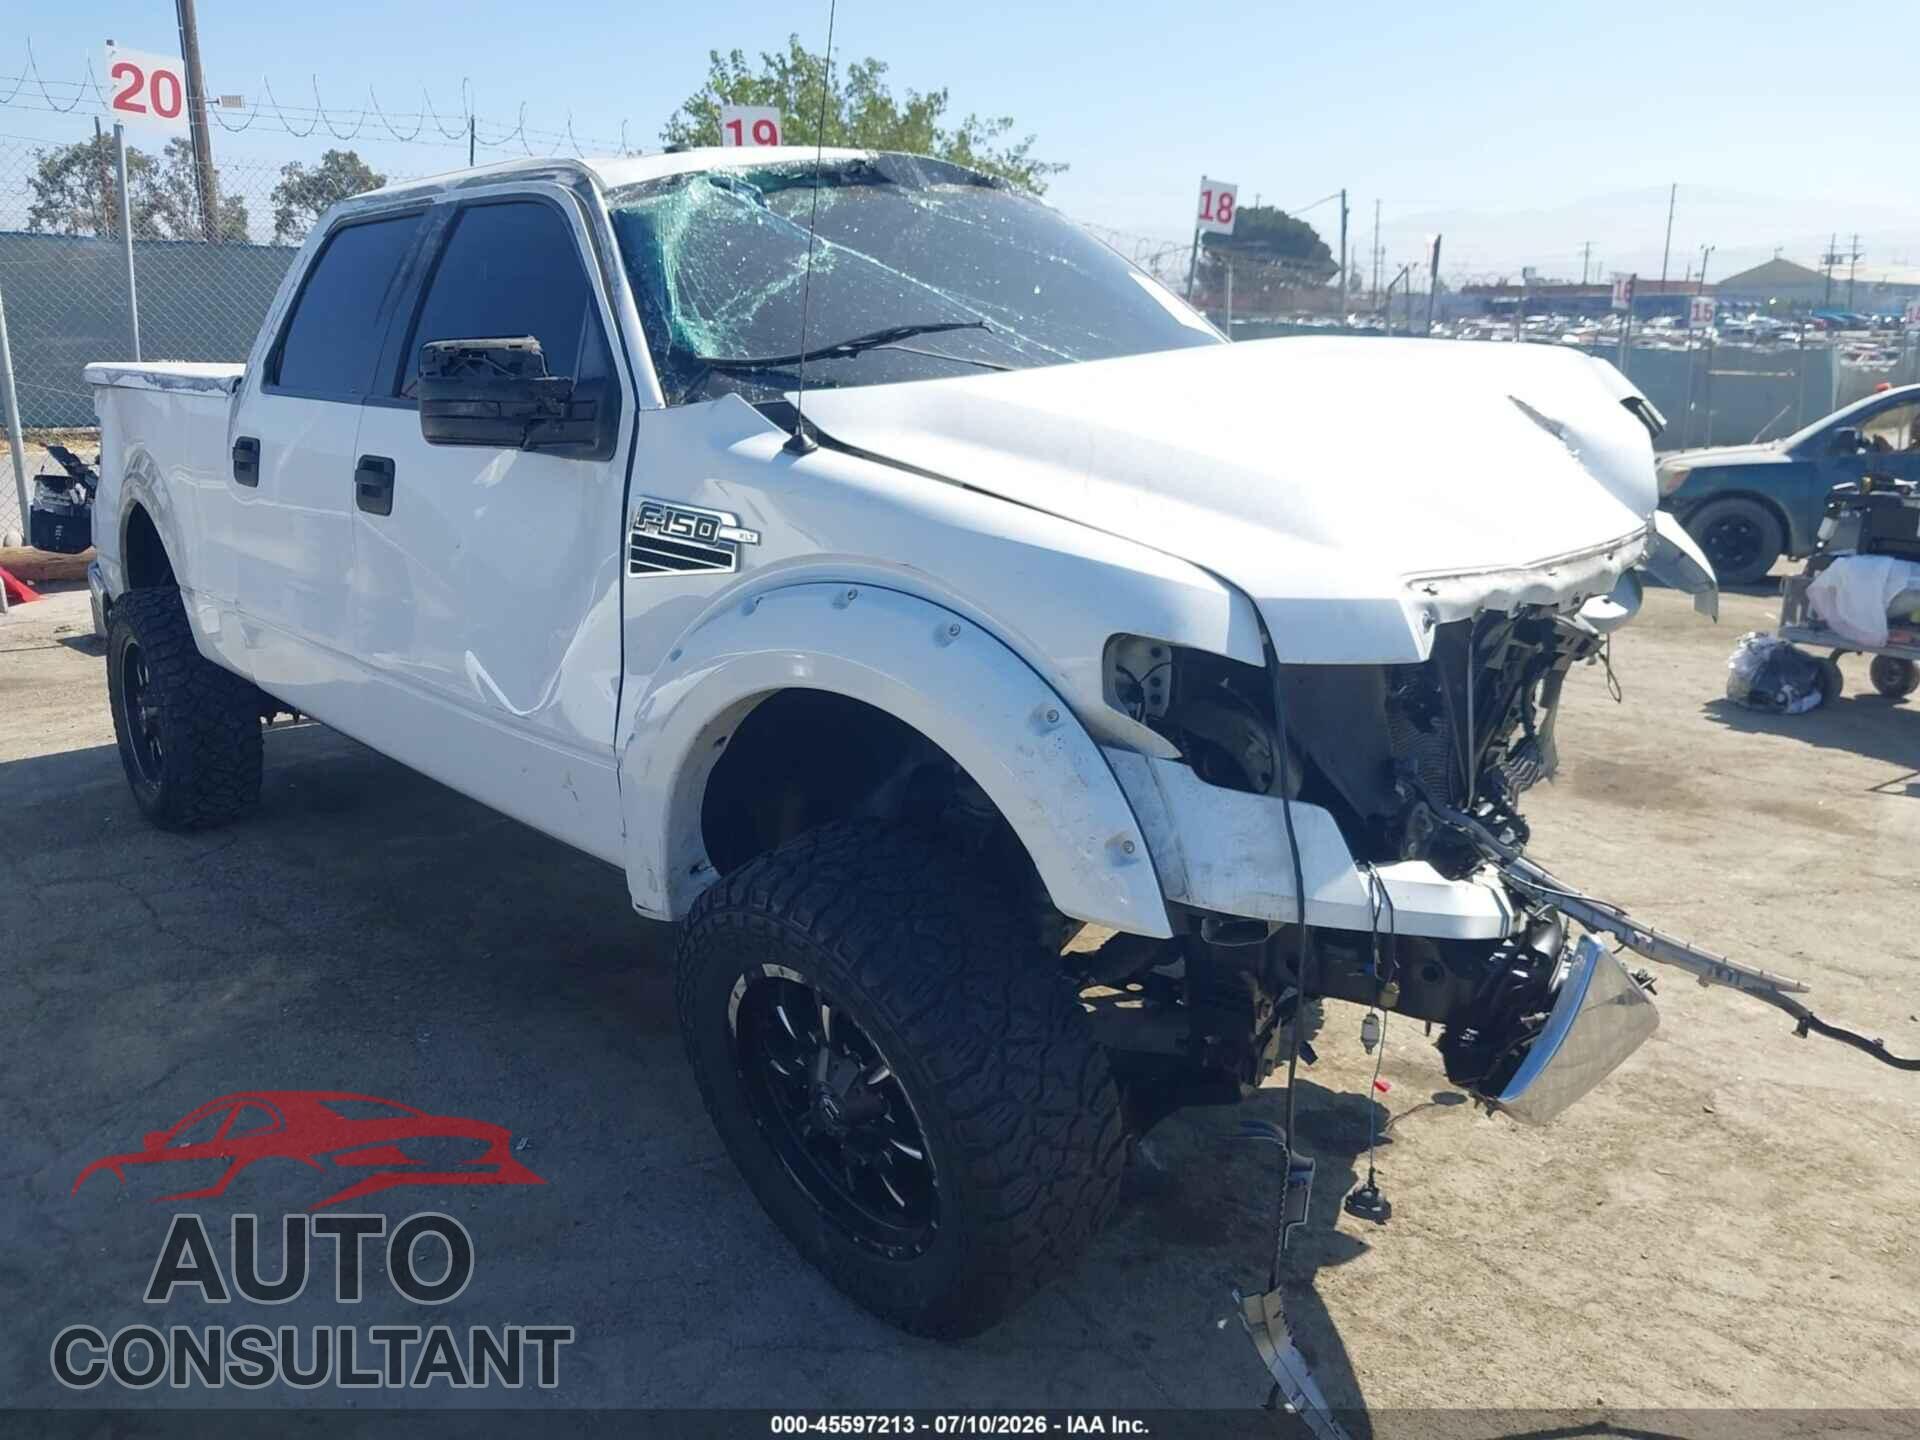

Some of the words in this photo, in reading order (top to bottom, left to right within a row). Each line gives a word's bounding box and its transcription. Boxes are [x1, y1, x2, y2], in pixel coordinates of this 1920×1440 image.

[111, 62, 182, 119] 20
[725, 118, 778, 146] 19
[1199, 189, 1233, 224] 18
[1692, 303, 1713, 322] 15
[633, 501, 721, 544] F-150
